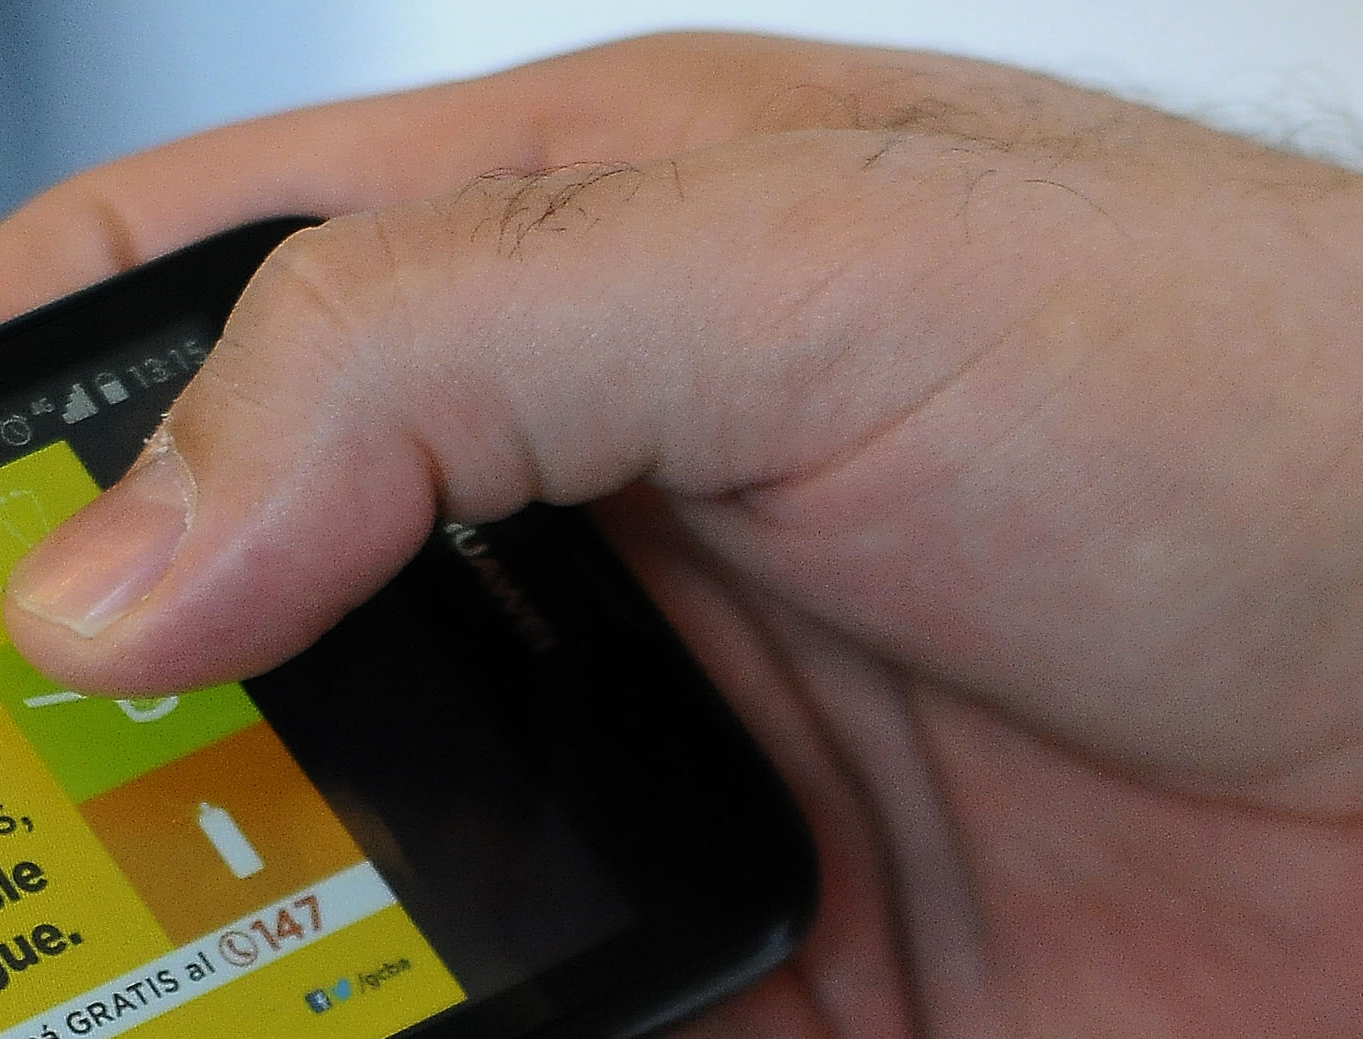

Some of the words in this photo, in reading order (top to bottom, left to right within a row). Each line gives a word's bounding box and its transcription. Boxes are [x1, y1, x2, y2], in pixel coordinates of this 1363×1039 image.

[66, 970, 179, 1034] GRATIS
[185, 952, 215, 981] al
[251, 895, 322, 950] 147
